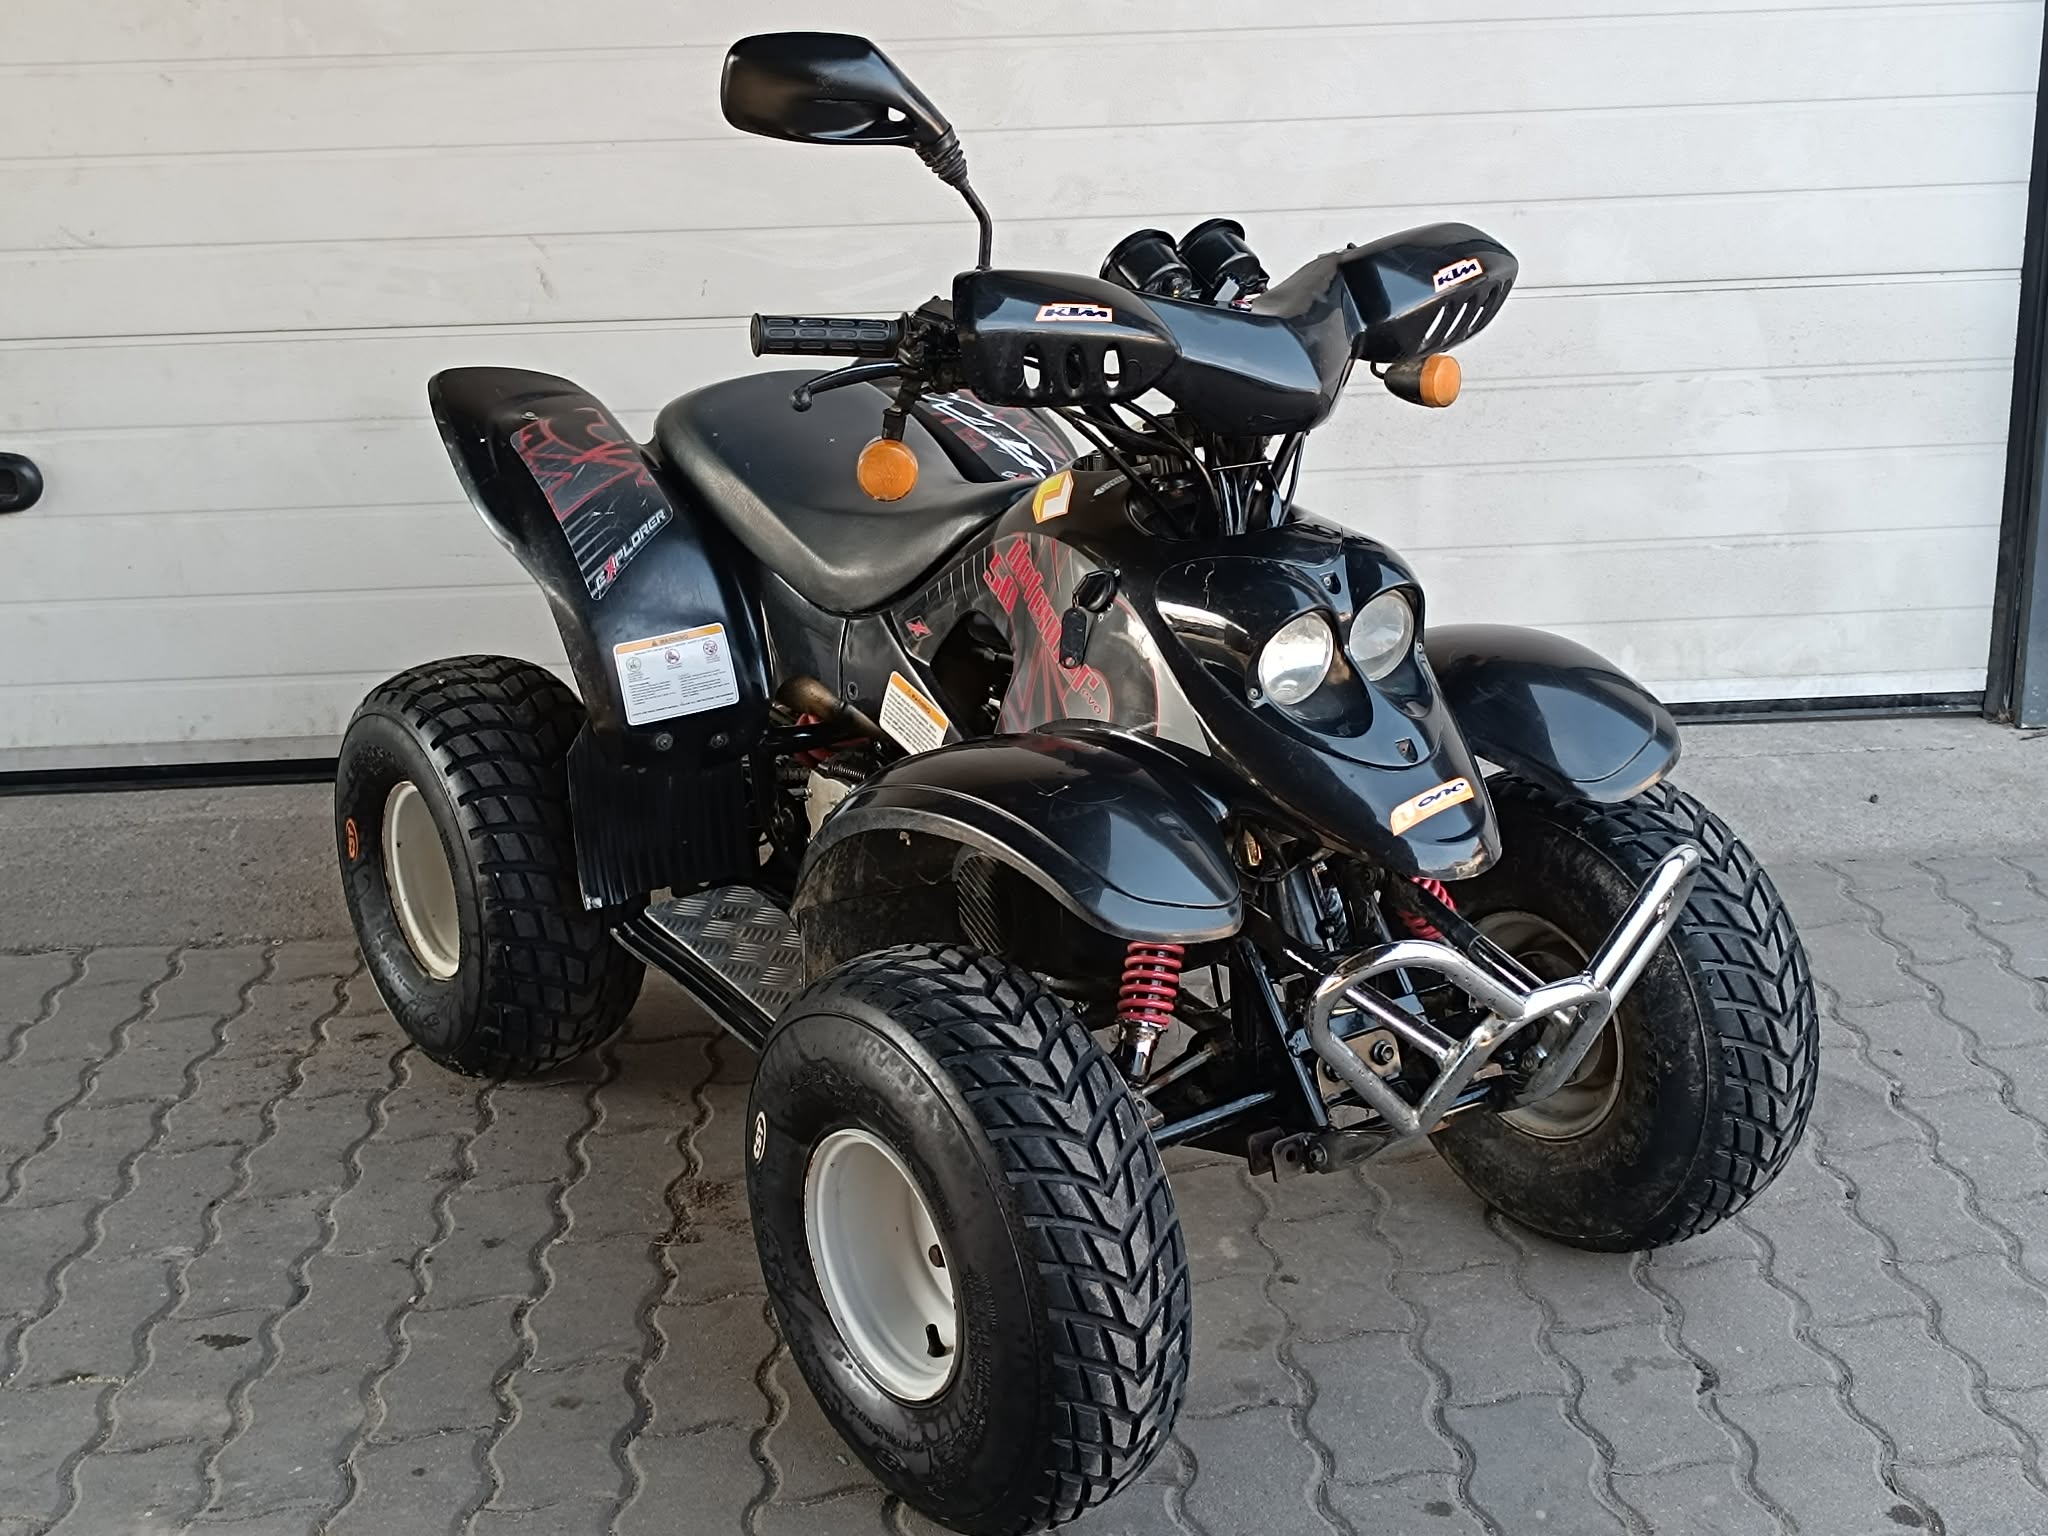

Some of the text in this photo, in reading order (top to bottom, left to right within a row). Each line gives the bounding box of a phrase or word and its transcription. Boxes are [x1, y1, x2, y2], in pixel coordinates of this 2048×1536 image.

[1437, 263, 1478, 287] KTM
[1043, 306, 1108, 318] KTM
[594, 509, 668, 591] EXPLORER
[983, 553, 1019, 616] 50
[753, 1120, 764, 1160] CST
